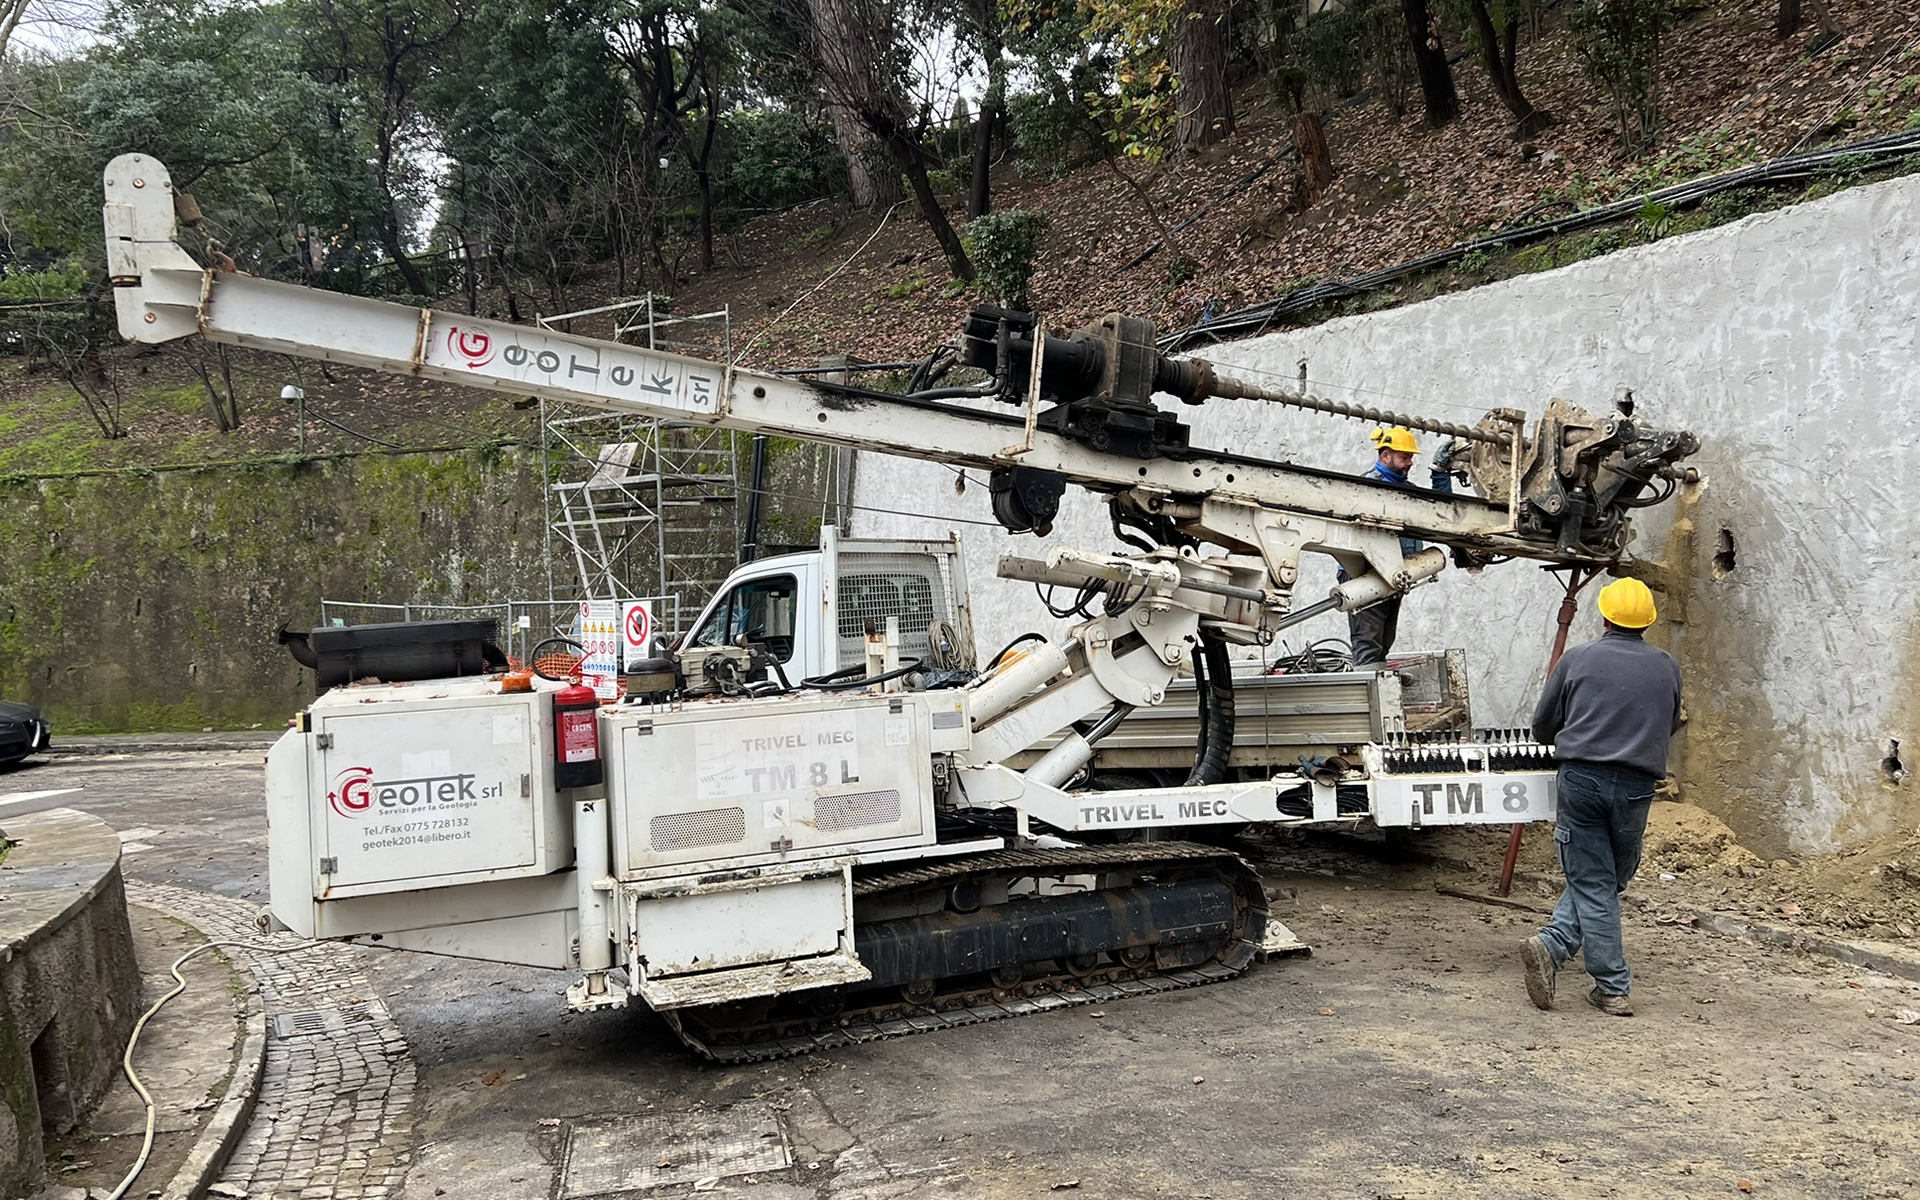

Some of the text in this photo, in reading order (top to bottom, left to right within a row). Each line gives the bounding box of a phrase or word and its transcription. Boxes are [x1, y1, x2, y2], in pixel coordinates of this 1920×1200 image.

[459, 333, 673, 395] GeoTek
[689, 375, 711, 405] srl
[742, 730, 854, 752] TRIVEL MEC
[744, 759, 860, 793] TM 8 L
[342, 773, 503, 809] GeoTek srl
[1412, 782, 1484, 815] TM
[1502, 781, 1529, 814] 8
[379, 807, 409, 816] Servizi
[439, 801, 478, 810] Geologia
[1080, 800, 1228, 824] TRIVEL MEC
[363, 818, 469, 836] Tel./Fax 0775 728132
[362, 830, 471, 852] geotek2014@libero.it
